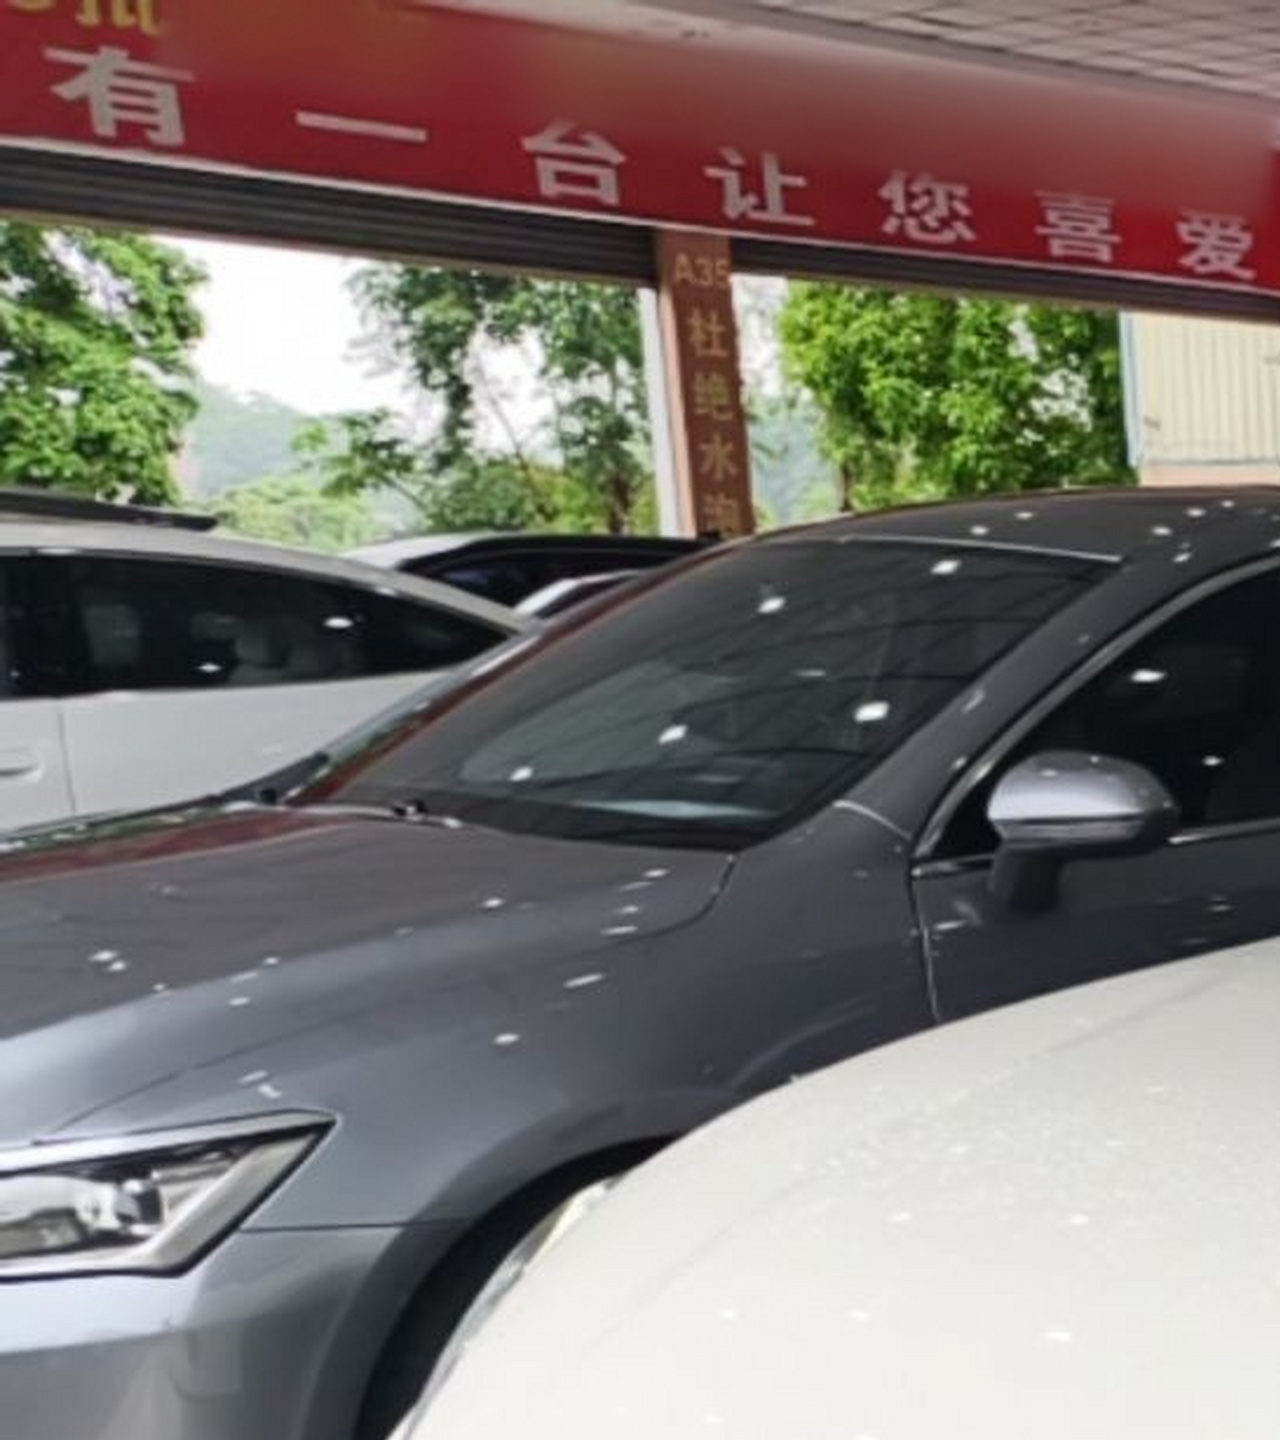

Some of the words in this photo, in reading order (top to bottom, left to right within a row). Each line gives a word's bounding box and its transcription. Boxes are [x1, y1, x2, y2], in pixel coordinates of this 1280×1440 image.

[42, 44, 1257, 281] 有一台让您喜爱
